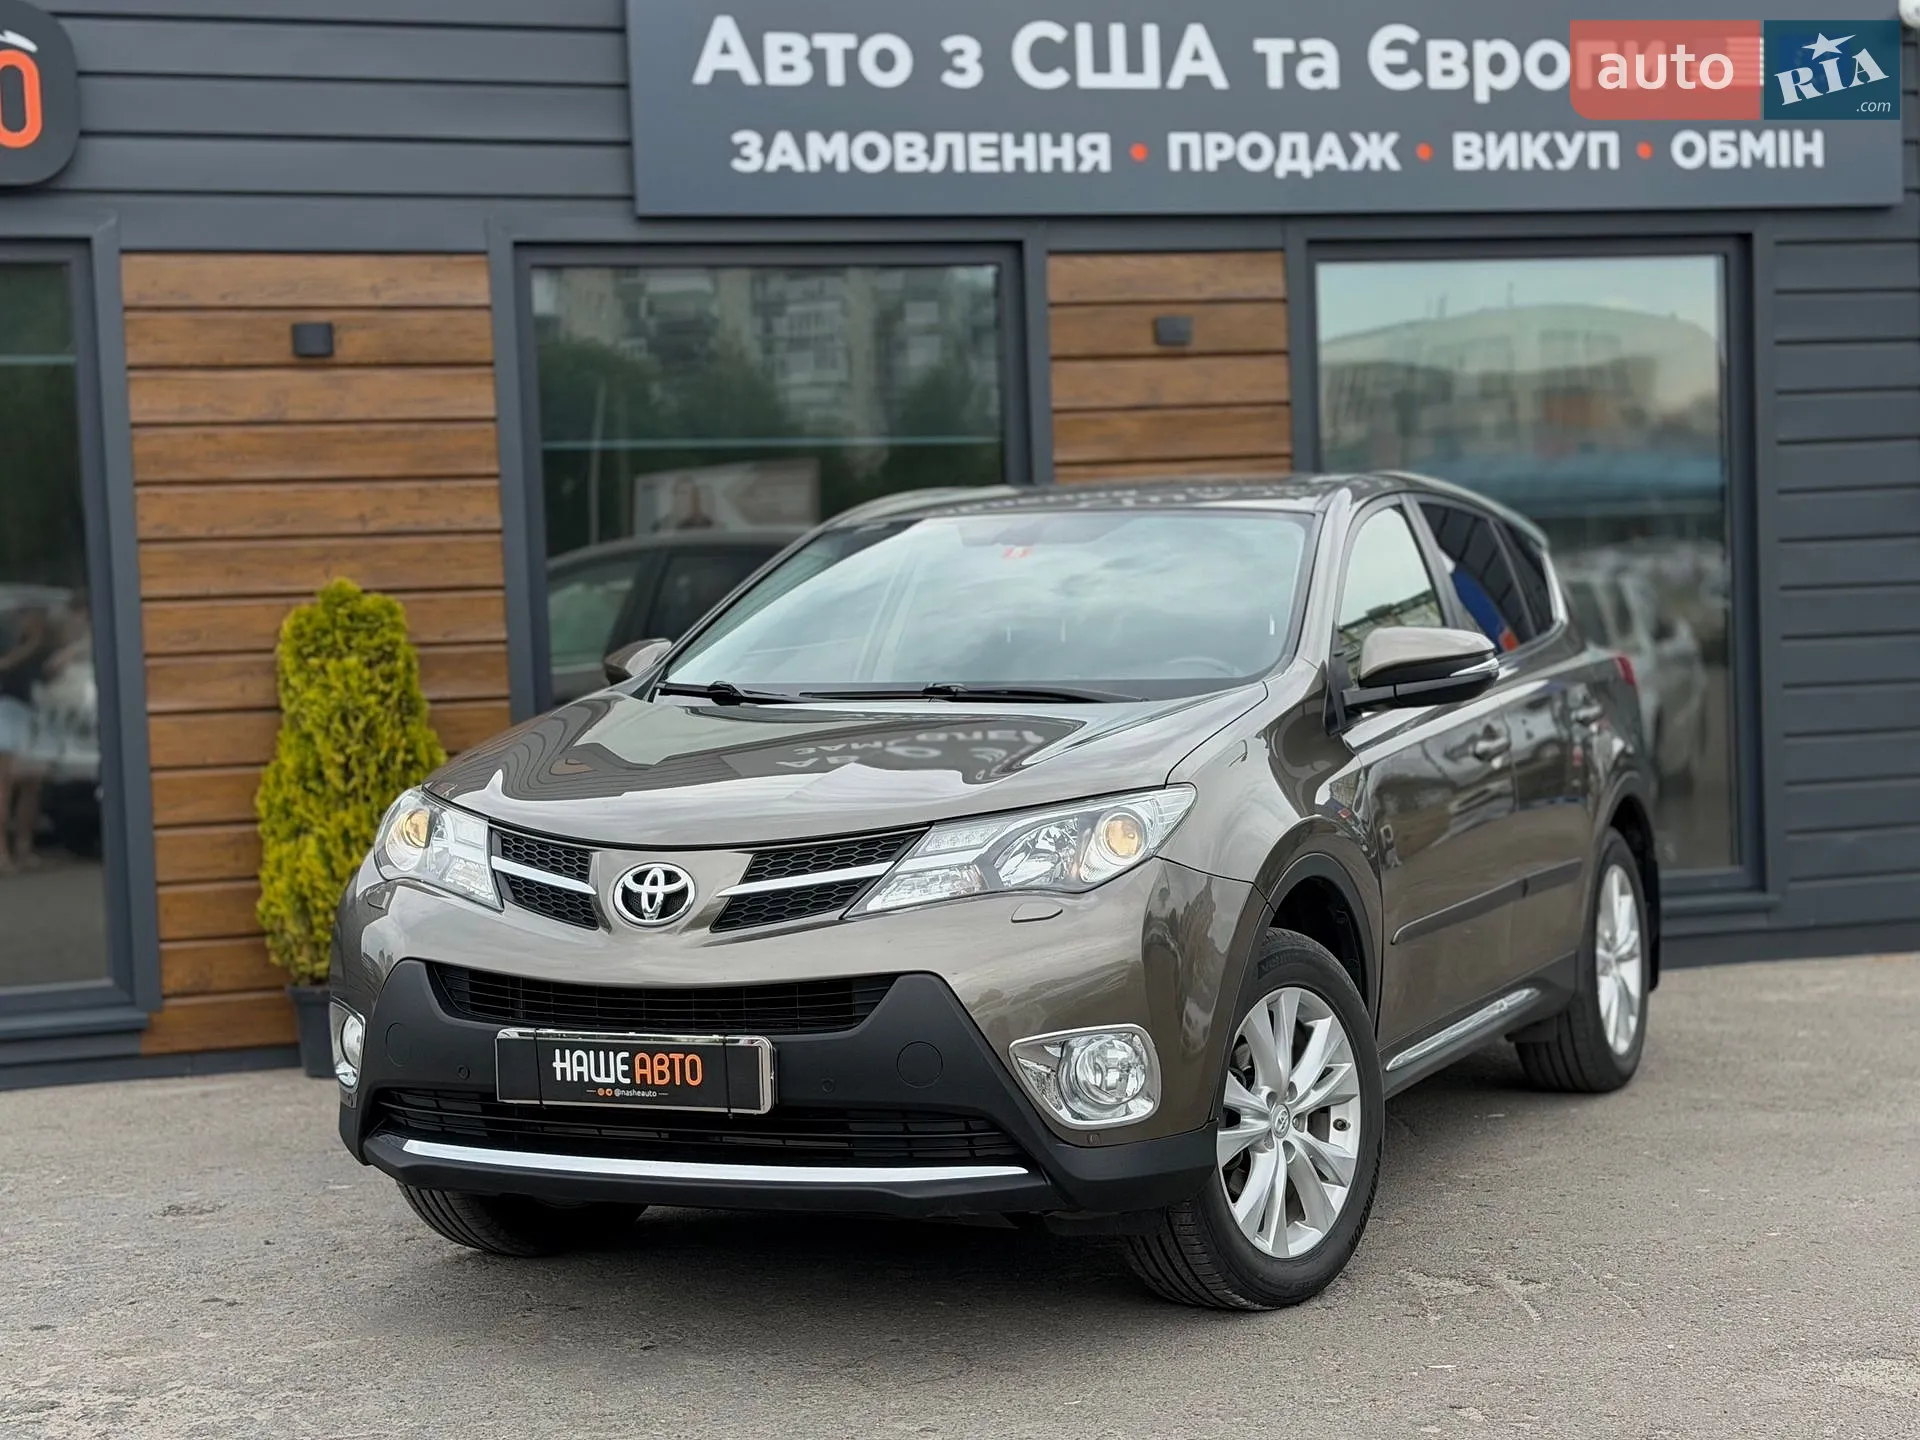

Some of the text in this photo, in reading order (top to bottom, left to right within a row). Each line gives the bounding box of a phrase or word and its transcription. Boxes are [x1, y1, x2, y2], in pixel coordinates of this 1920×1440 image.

[692, 14, 914, 89] Авто
[940, 34, 984, 89] з
[1011, 20, 1230, 90] США
[1252, 37, 1341, 91] та
[730, 129, 1826, 179] ЗАМОВЛЕННЯ ПРОДАЖ ВИКУП ОБМІН
